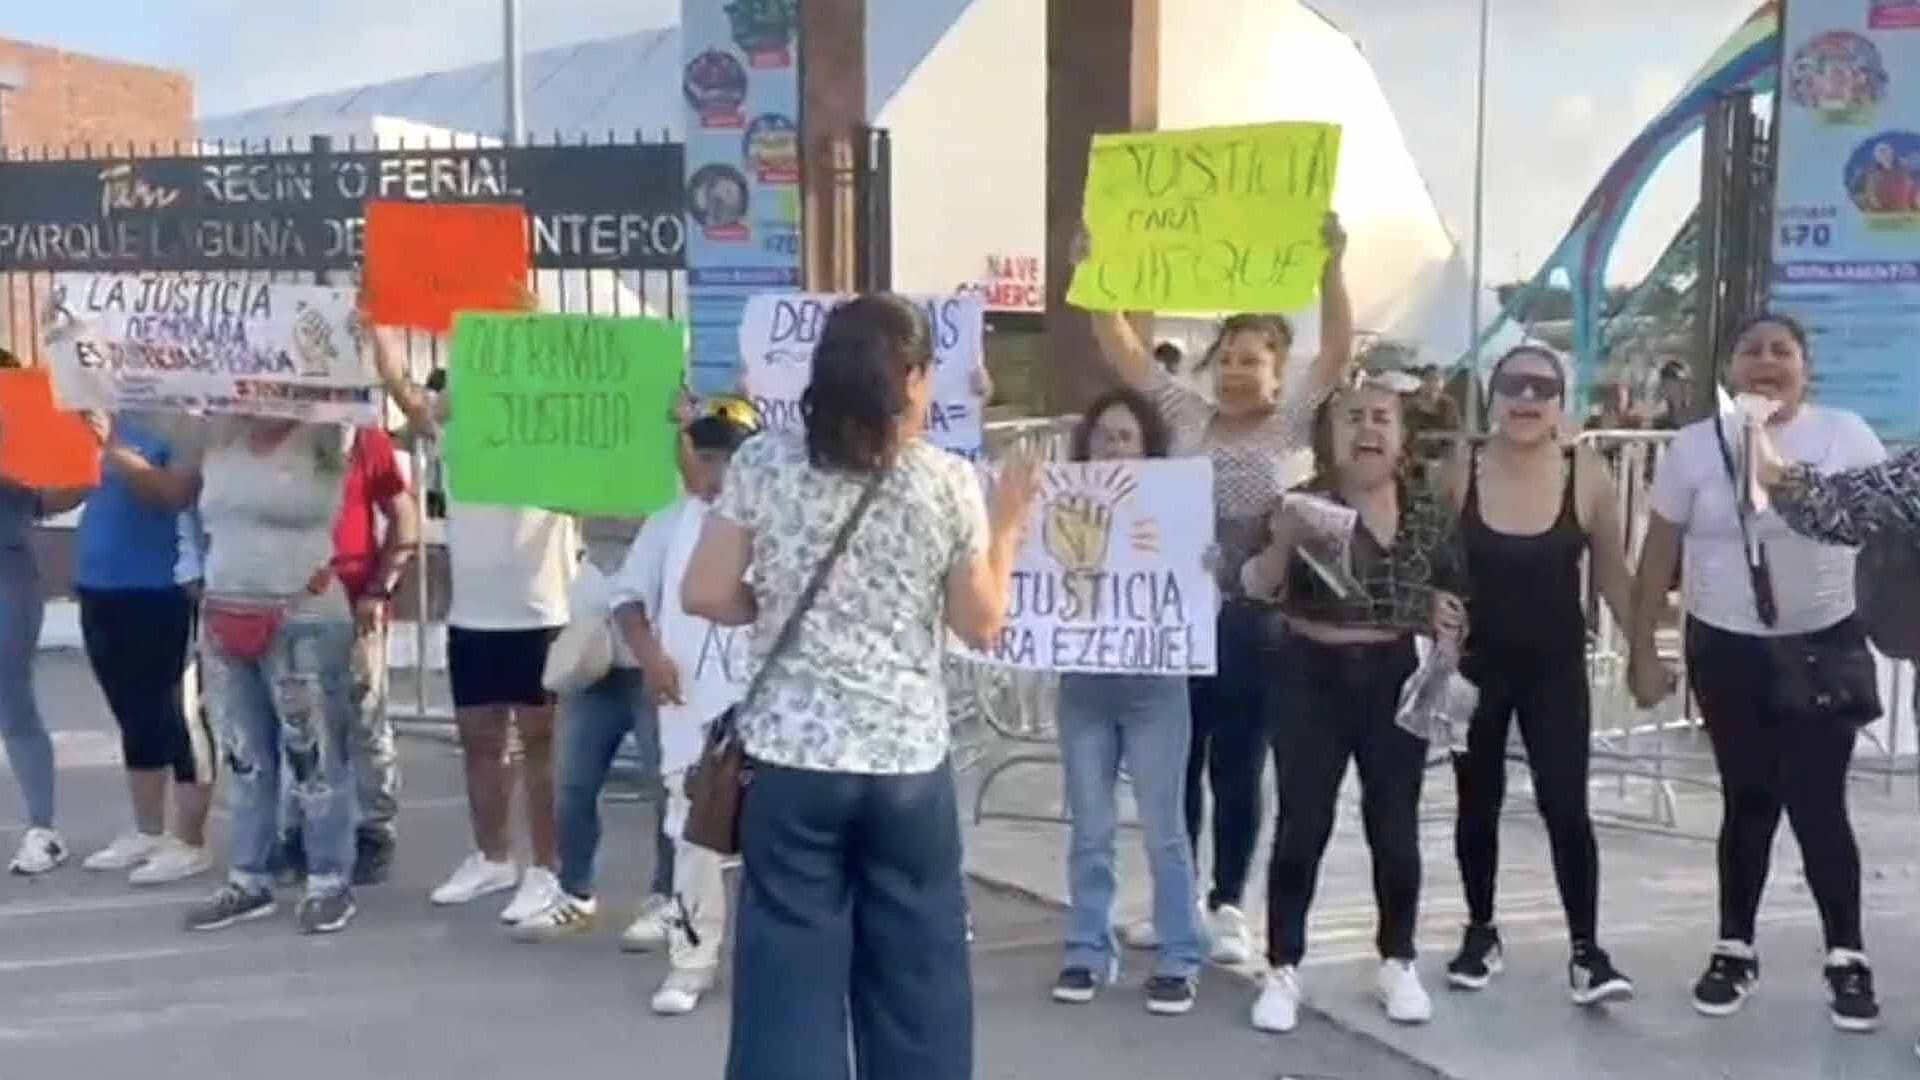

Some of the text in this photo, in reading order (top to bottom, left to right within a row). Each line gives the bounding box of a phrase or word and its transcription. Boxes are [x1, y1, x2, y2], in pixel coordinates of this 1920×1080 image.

[380, 157, 523, 199] FERIAL
[88, 274, 271, 319] LA JUSTICIA
[1008, 569, 1184, 624] JUSTICIA
